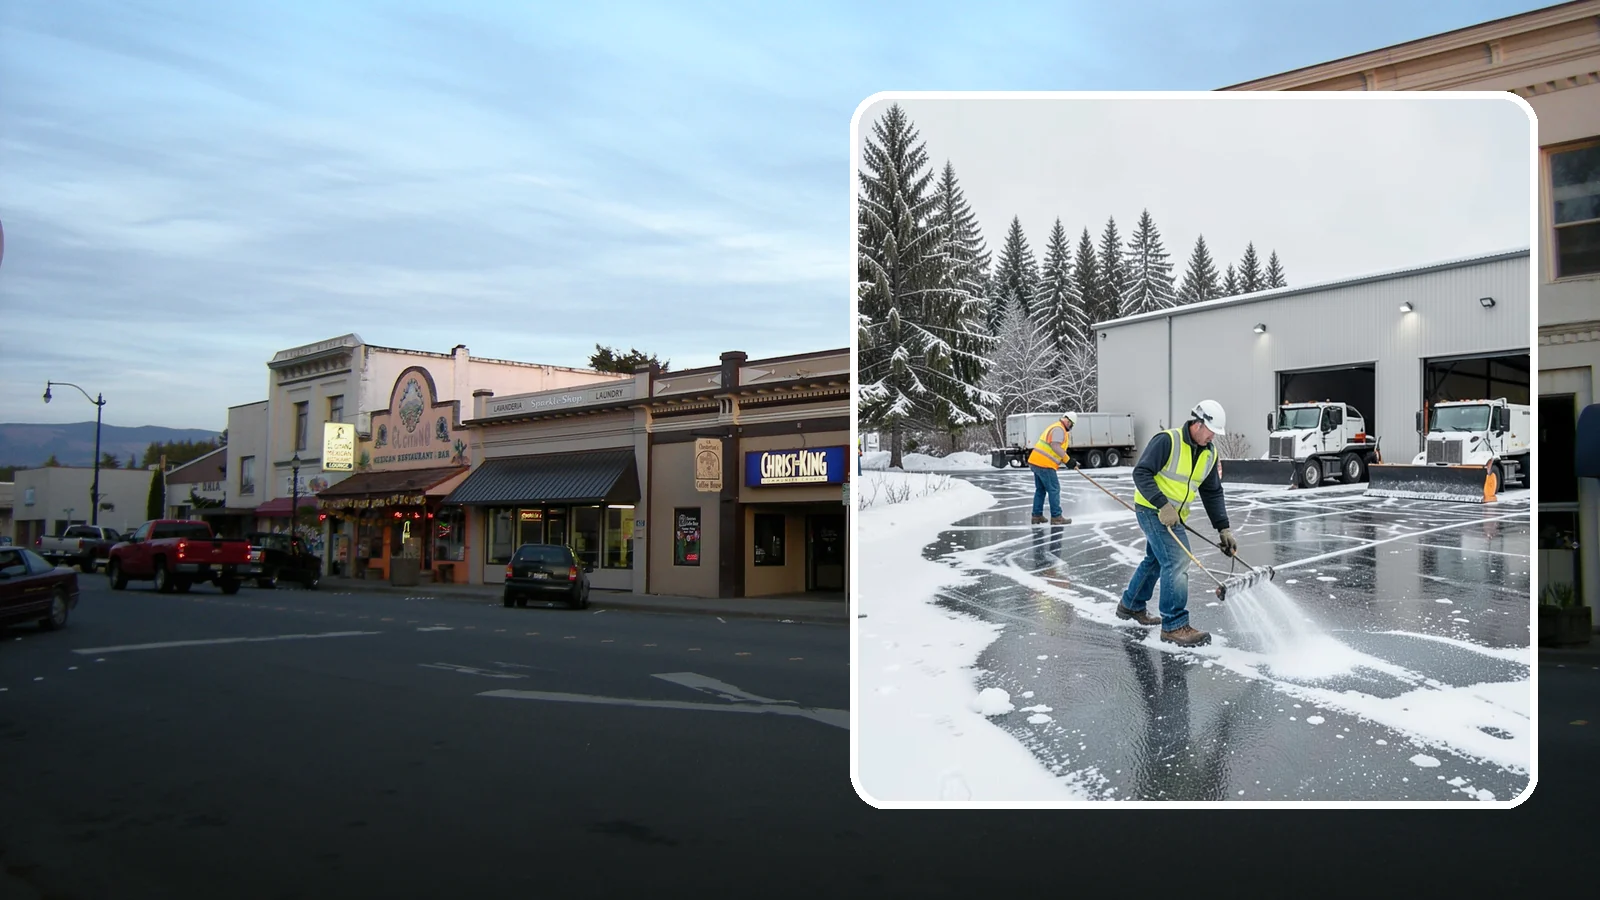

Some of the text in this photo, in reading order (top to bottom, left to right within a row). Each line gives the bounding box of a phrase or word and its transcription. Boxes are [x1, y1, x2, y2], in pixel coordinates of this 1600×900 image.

[562, 394, 583, 405] Shop
[595, 389, 624, 400] LAUNDRY
[493, 402, 523, 413] LAVANDERIA
[397, 451, 434, 462] RESTAURANT
[437, 450, 450, 459] BAR
[761, 450, 827, 478] CHRIST KING
